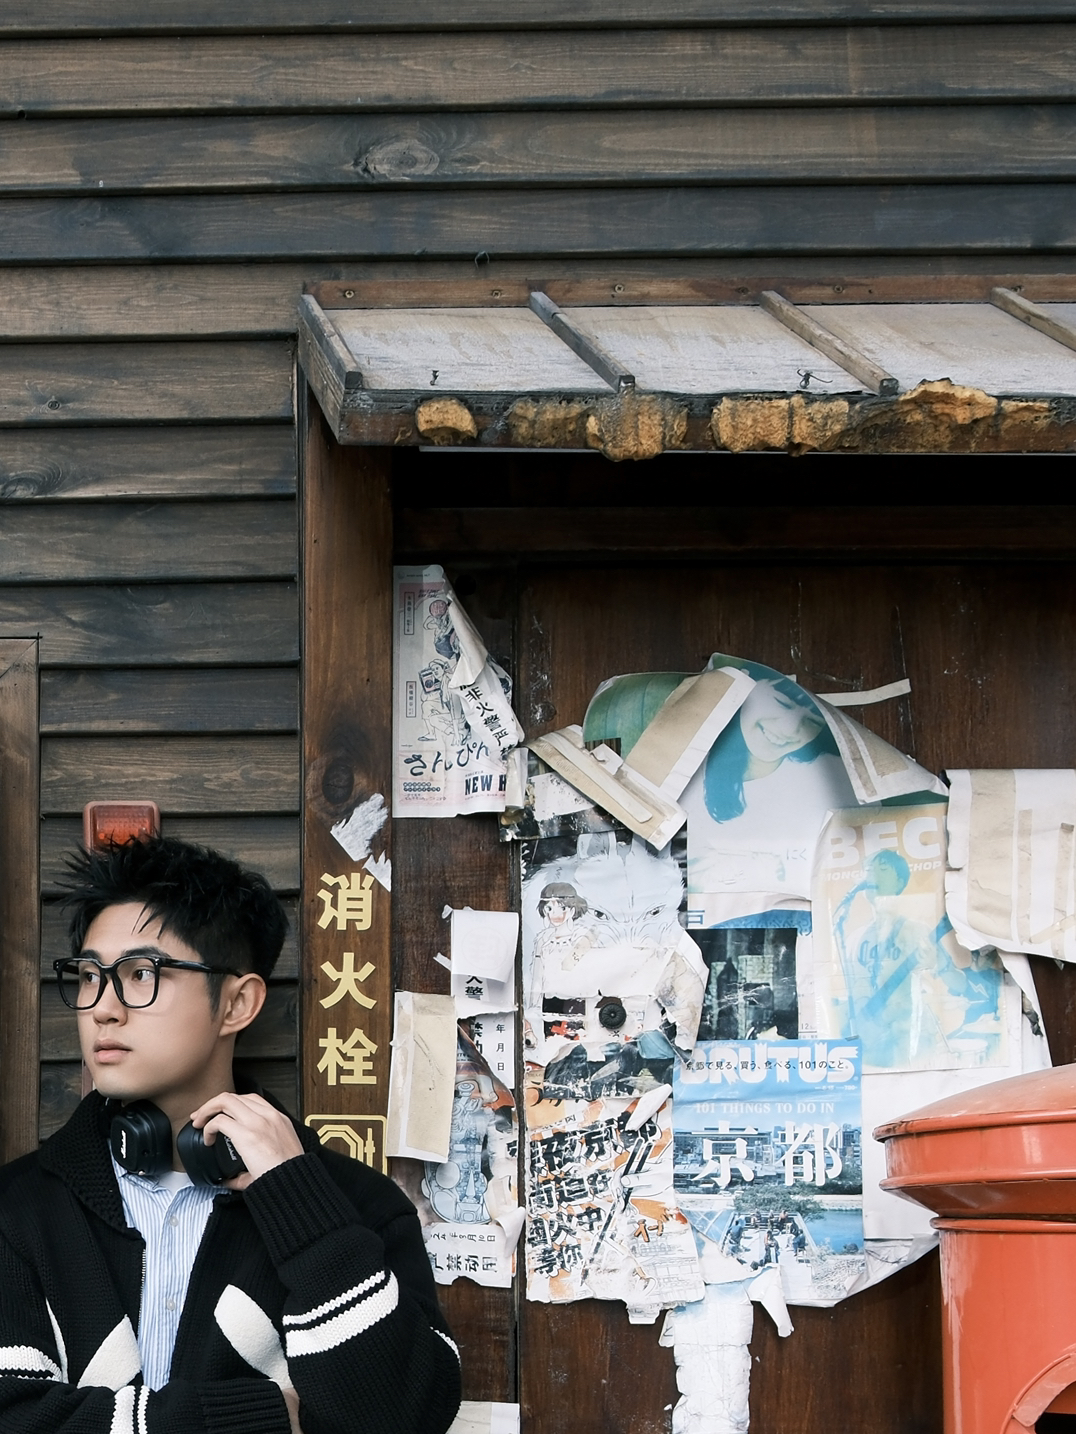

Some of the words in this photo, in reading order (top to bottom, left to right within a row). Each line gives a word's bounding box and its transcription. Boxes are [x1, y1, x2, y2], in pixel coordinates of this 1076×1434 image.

[465, 774, 493, 795] NEW
[317, 872, 379, 1087] 消火栓
[680, 1042, 859, 1086] BRUTUS
[696, 1103, 715, 1115] 101
[721, 1102, 771, 1115] THINGS
[776, 1102, 793, 1114] TO
[797, 1102, 817, 1114] DO
[820, 1102, 834, 1114] IN
[691, 1120, 843, 1187] 京都
